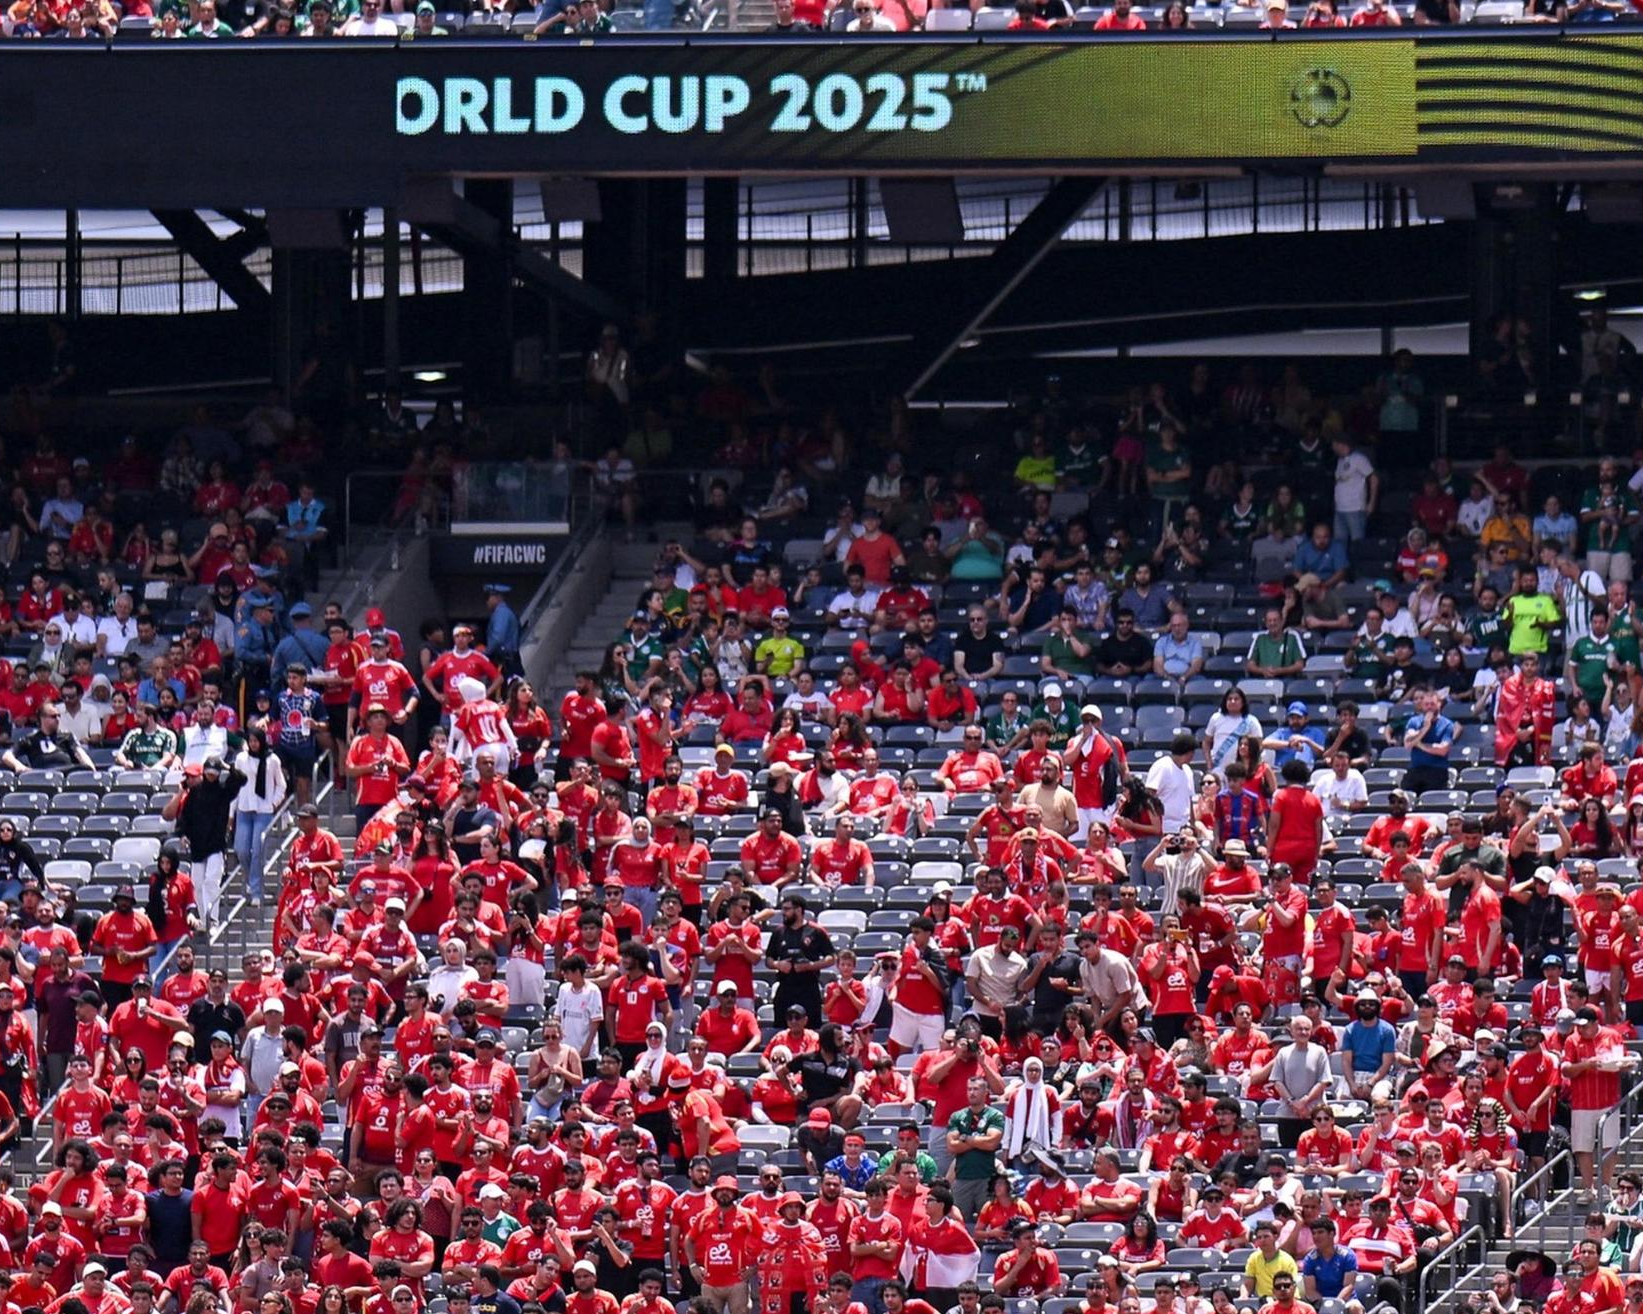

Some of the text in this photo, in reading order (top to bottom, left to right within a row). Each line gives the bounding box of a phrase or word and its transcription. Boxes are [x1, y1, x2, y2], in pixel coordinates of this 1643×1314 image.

[603, 75, 751, 134] CUP
[473, 544, 546, 564] #FIFACWC
[479, 718, 499, 743] 10
